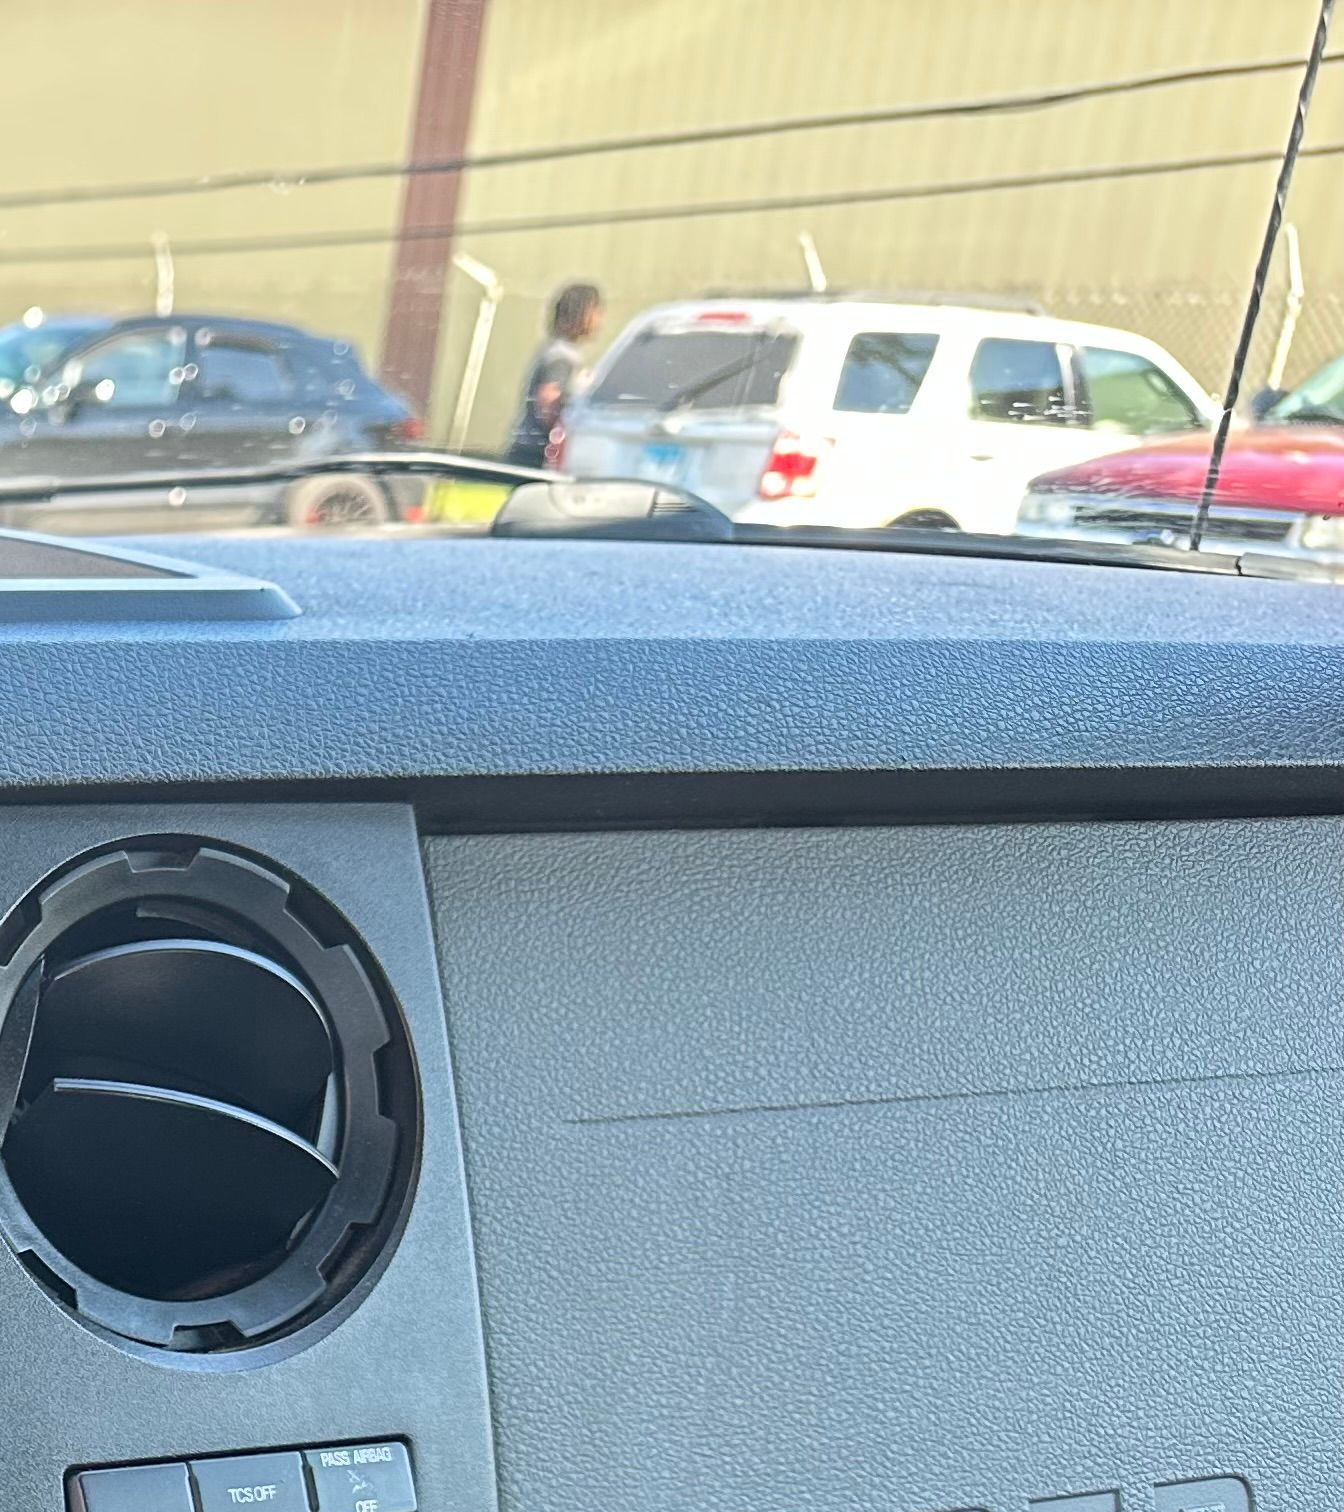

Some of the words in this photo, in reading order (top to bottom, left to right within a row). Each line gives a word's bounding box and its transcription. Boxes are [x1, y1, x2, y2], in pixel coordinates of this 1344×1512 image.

[320, 1450, 351, 1467] PASS
[353, 1446, 393, 1464] AIRBAG
[227, 1487, 253, 1504] TCS
[253, 1484, 277, 1501] OFF
